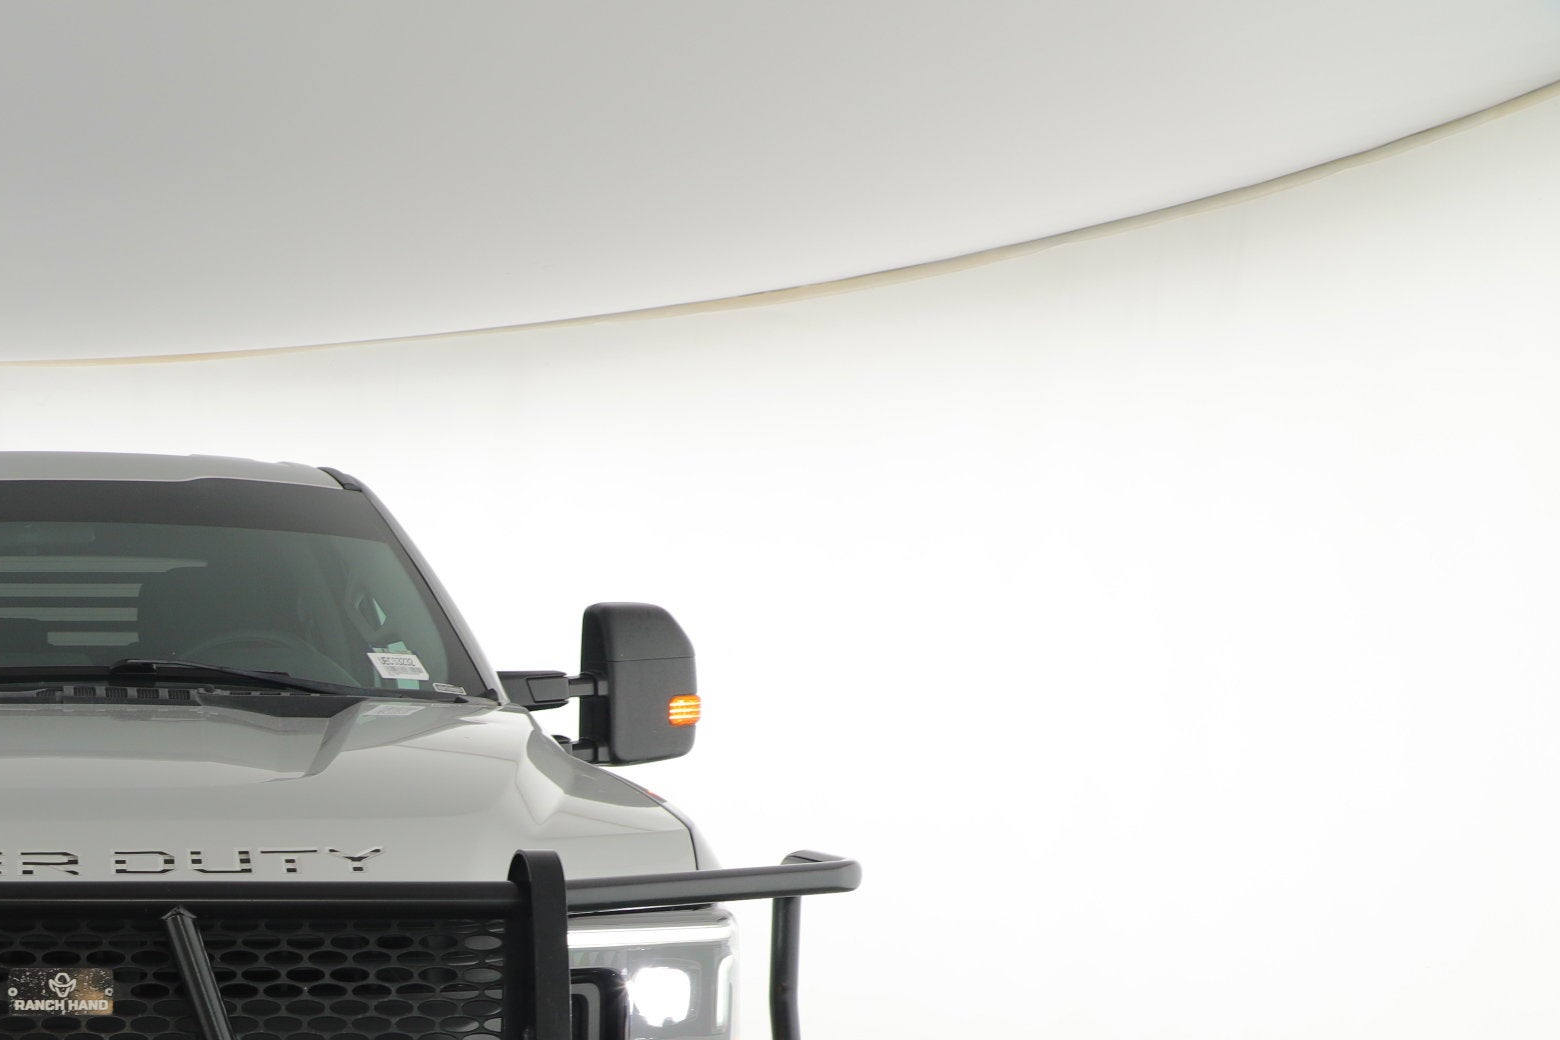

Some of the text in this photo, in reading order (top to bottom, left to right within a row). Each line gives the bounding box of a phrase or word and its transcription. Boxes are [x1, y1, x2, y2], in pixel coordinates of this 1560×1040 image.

[113, 848, 382, 875] DUTY
[14, 999, 109, 1011] RANCH HAND
